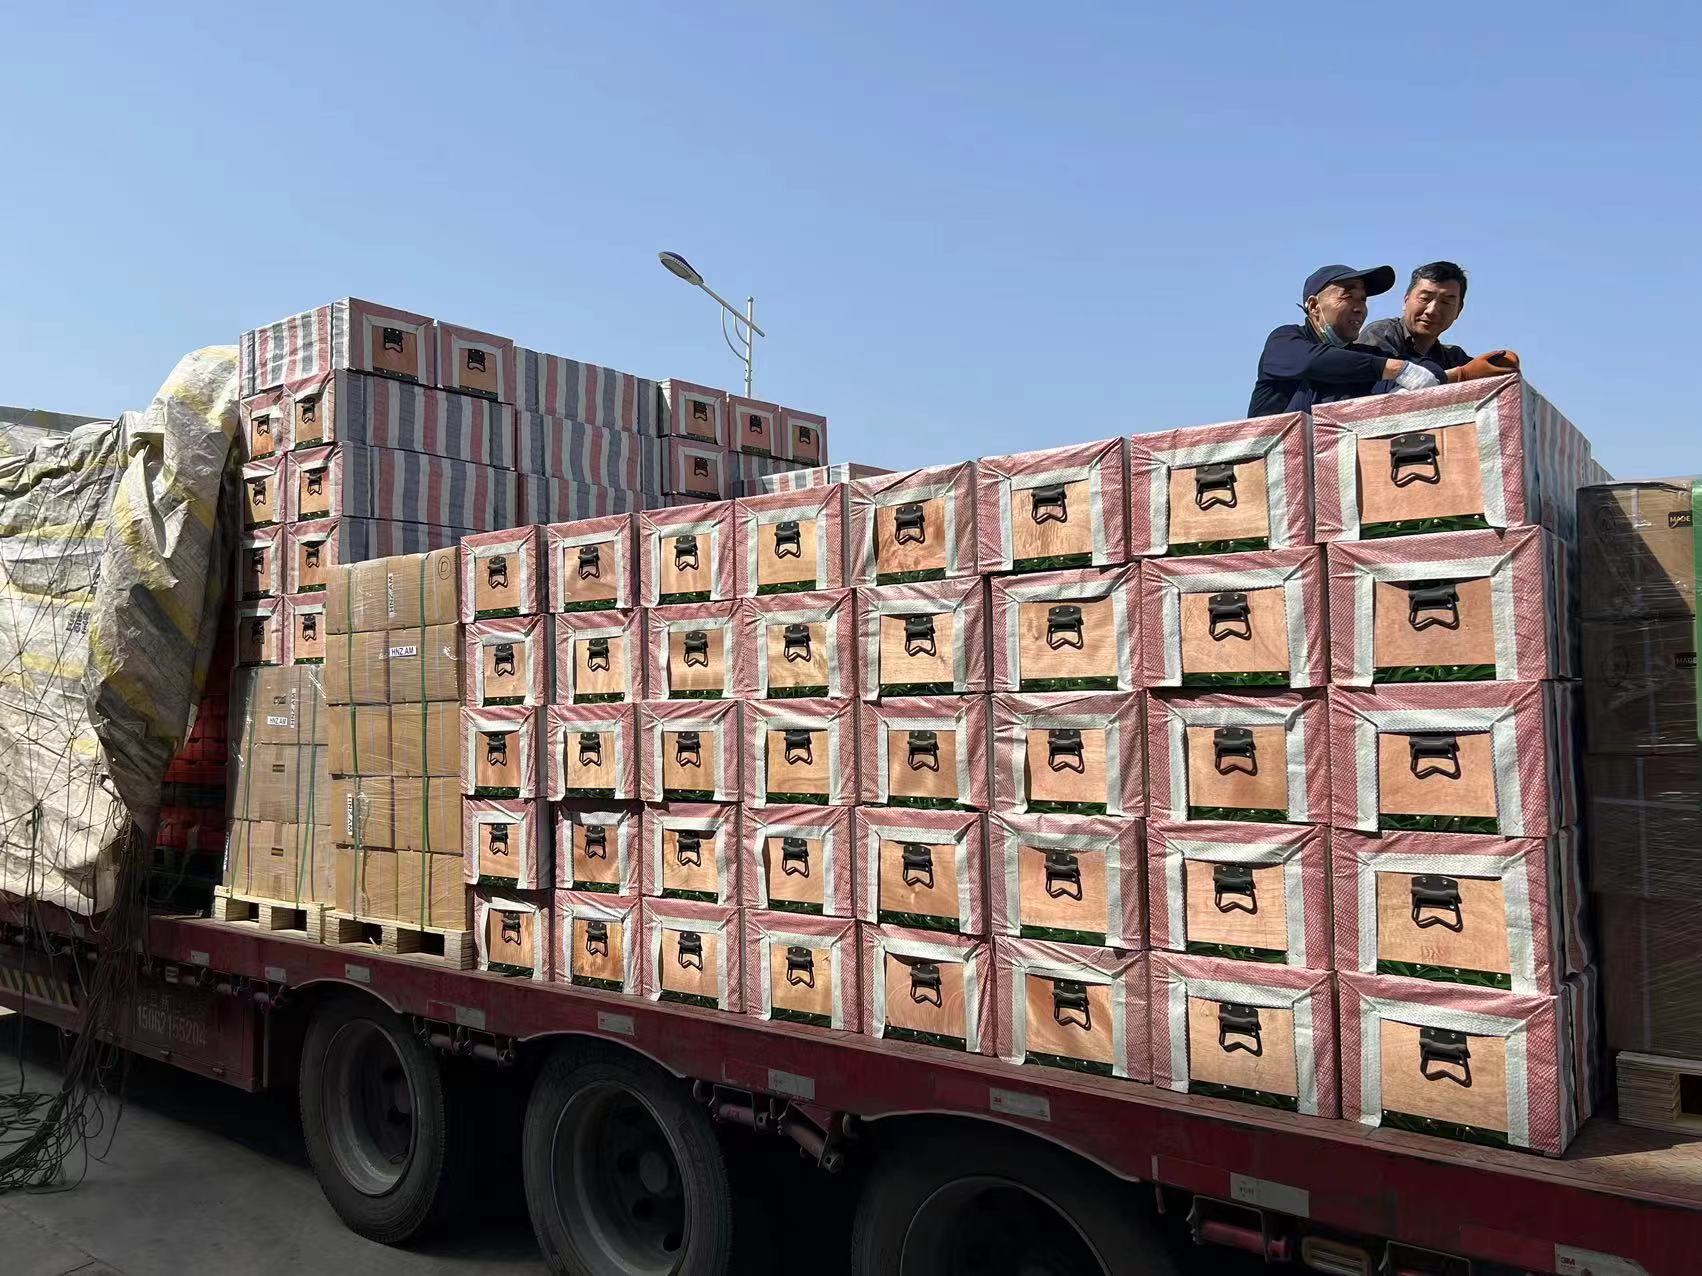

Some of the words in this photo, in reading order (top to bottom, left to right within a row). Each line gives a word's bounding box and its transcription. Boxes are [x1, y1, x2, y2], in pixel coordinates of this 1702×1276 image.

[391, 648, 403, 656] HNZ
[405, 647, 414, 655] AM
[269, 717, 279, 725] HNZ
[1560, 1256, 1575, 1265] 3M
